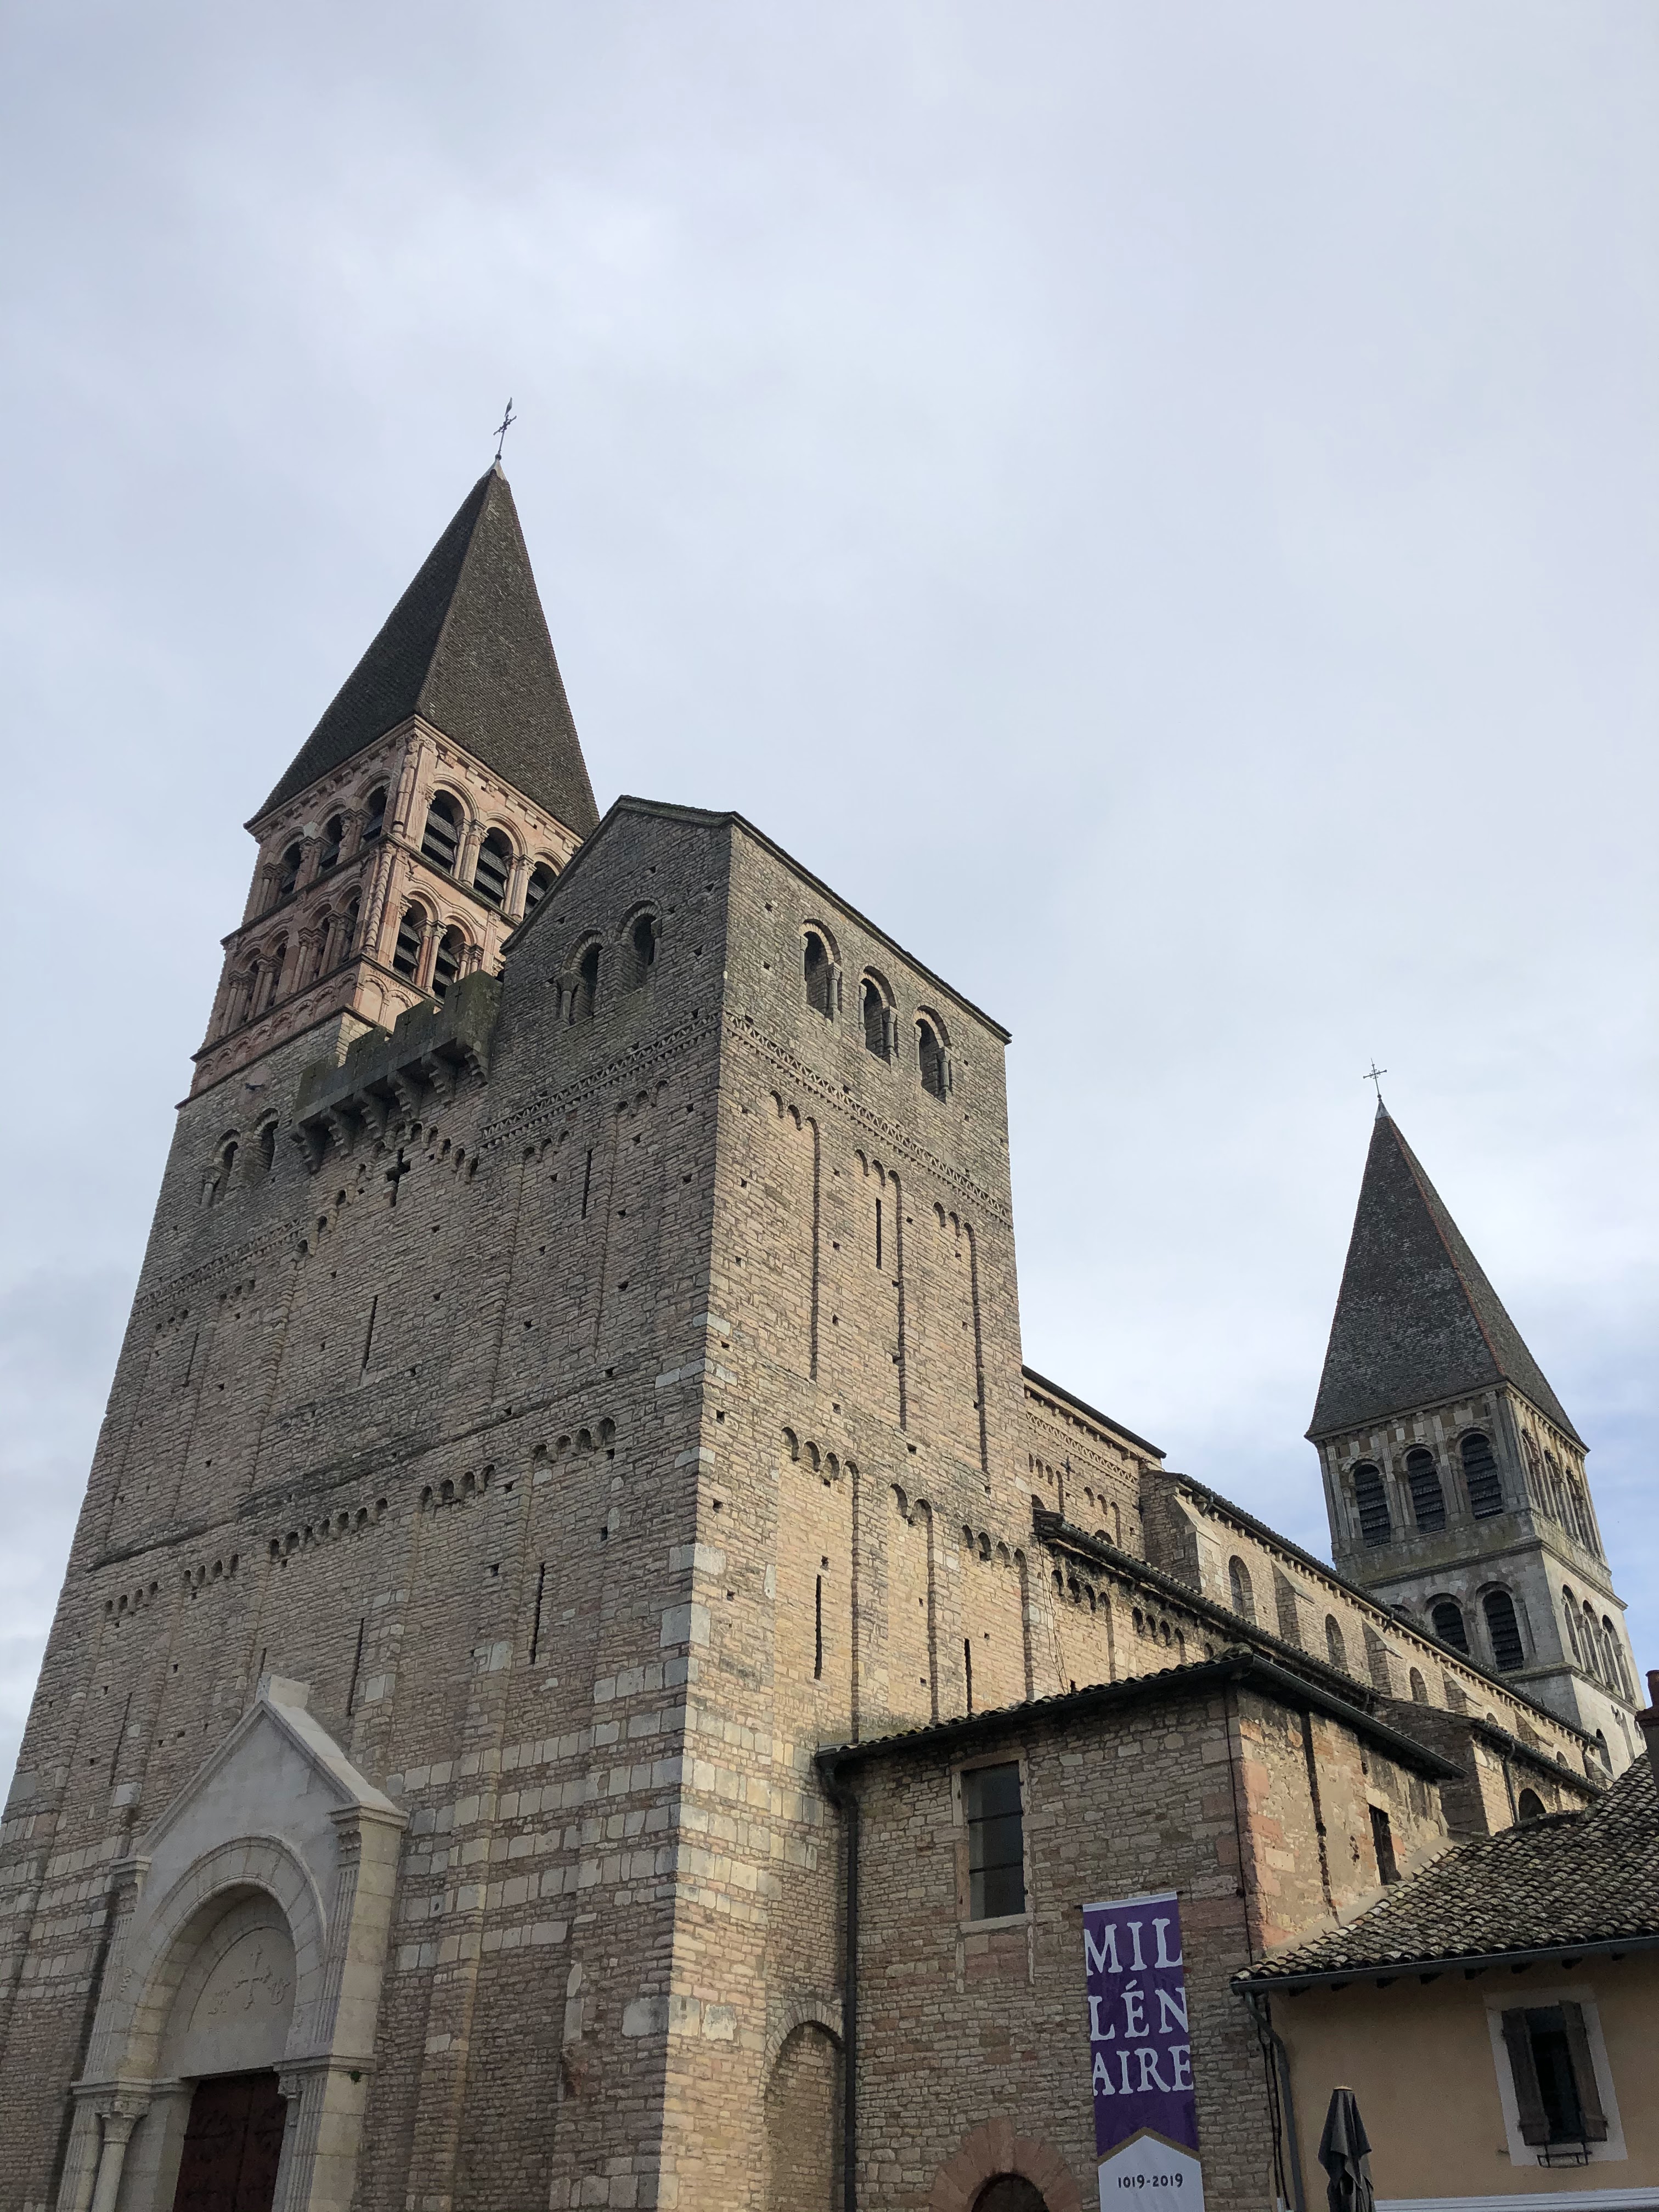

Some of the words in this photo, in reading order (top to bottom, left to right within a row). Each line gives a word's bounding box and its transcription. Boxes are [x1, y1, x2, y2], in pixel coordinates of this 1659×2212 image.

[1084, 1918, 1182, 1976] MIL
[1088, 1979, 1188, 2041] LÉN
[1093, 2045, 1193, 2096] AIRE
[1118, 2173, 1183, 2189] 1019-2019
